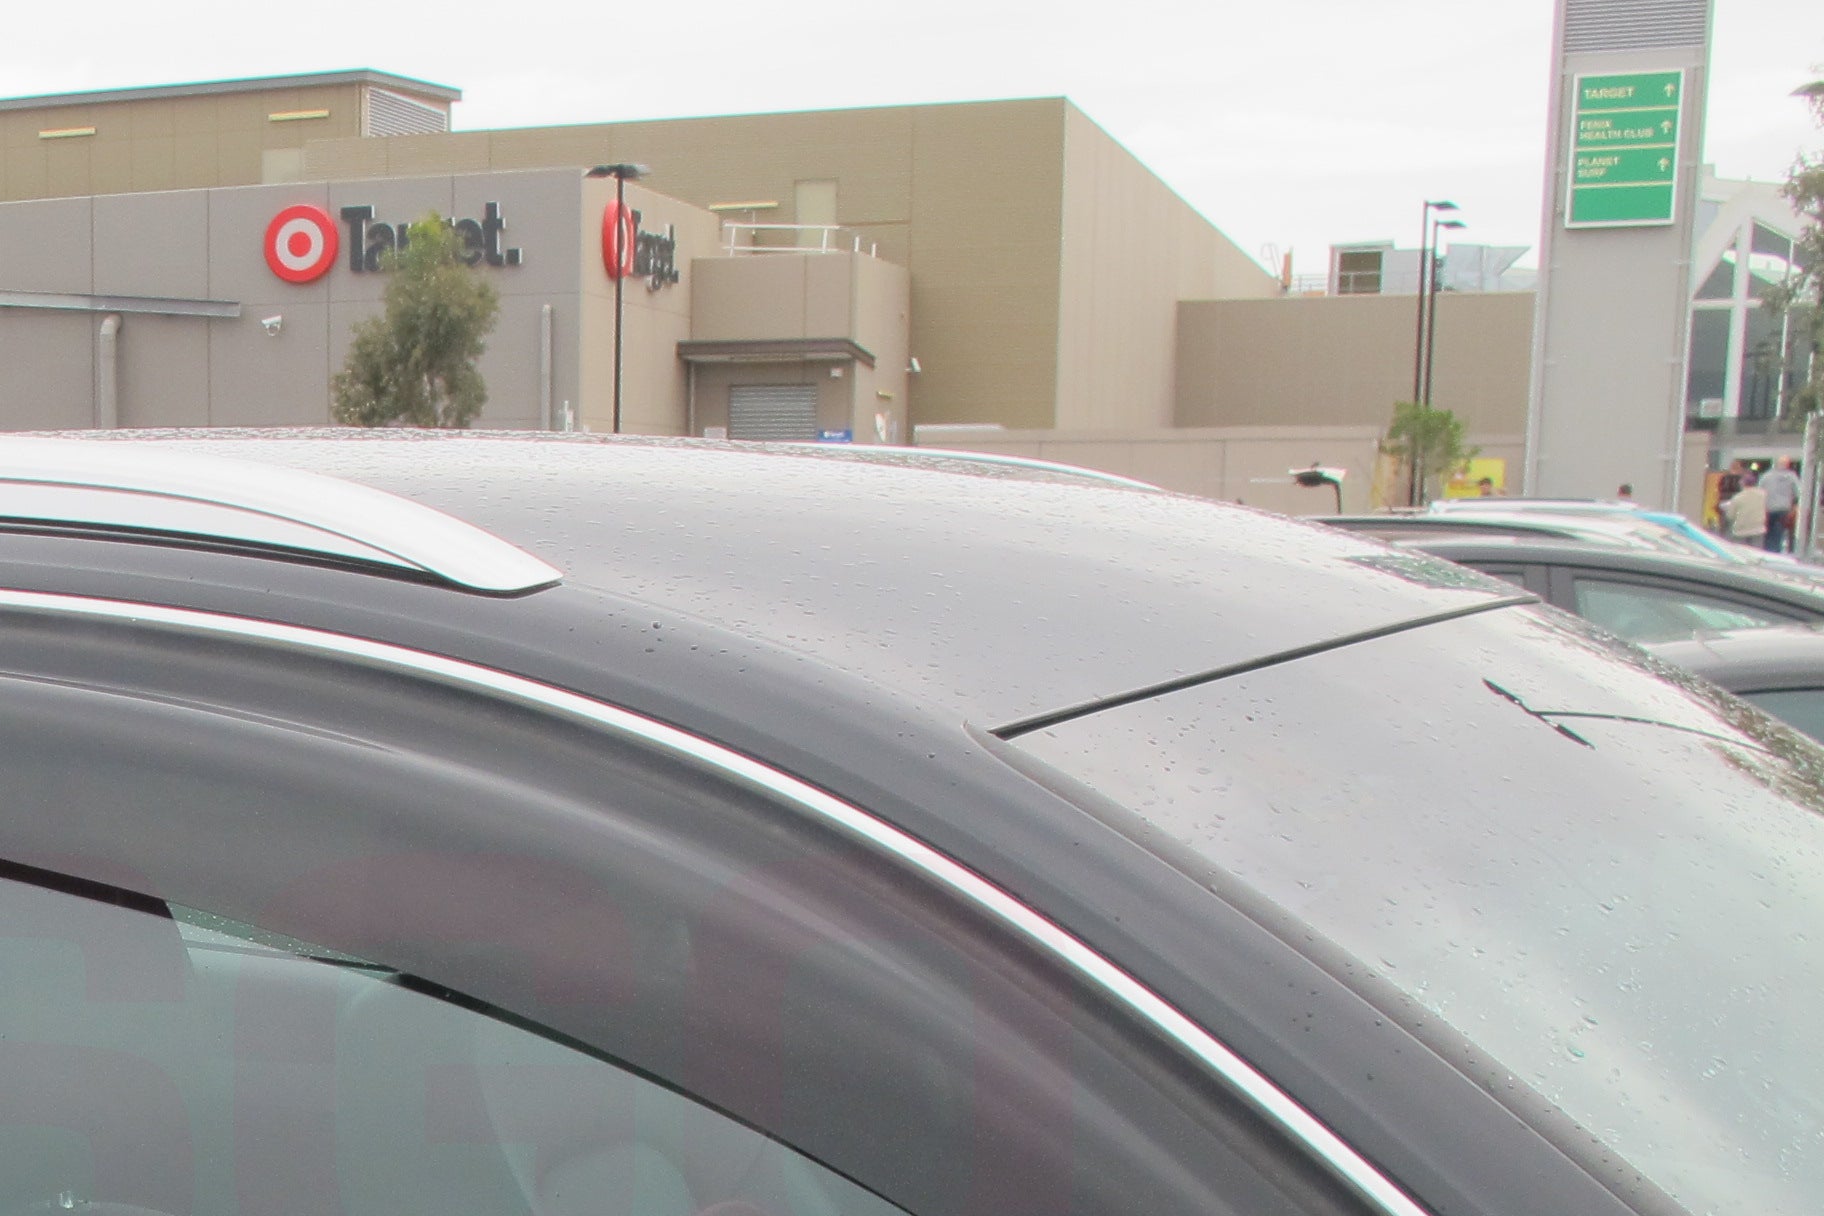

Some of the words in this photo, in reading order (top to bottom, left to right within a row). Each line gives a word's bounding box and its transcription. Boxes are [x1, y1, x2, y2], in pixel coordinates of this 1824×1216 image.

[1584, 86, 1635, 99] TARGET
[1580, 130, 1621, 140] HEALTH
[1624, 128, 1655, 138] CLUB
[1578, 156, 1620, 166] PLANET
